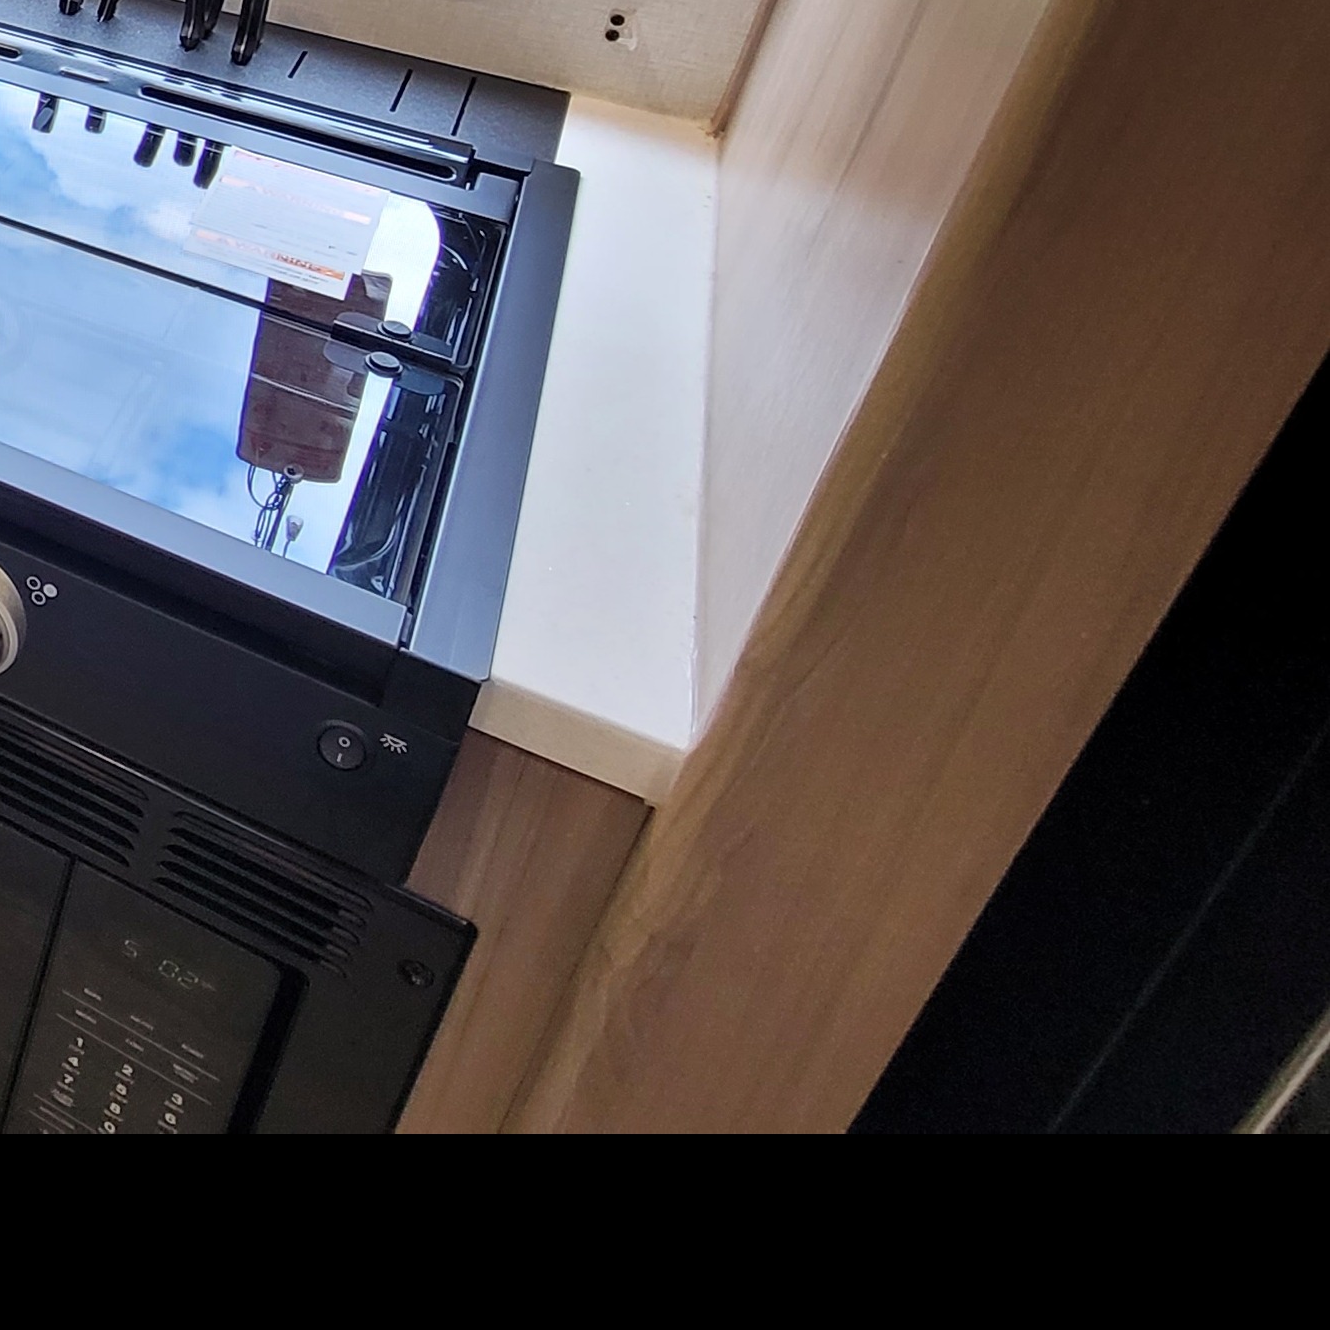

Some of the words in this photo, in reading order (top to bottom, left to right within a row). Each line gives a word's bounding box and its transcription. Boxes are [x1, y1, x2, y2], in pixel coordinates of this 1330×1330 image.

[76, 1036, 84, 1048] 1
[121, 1063, 134, 1077] 2
[171, 1092, 183, 1106] 3
